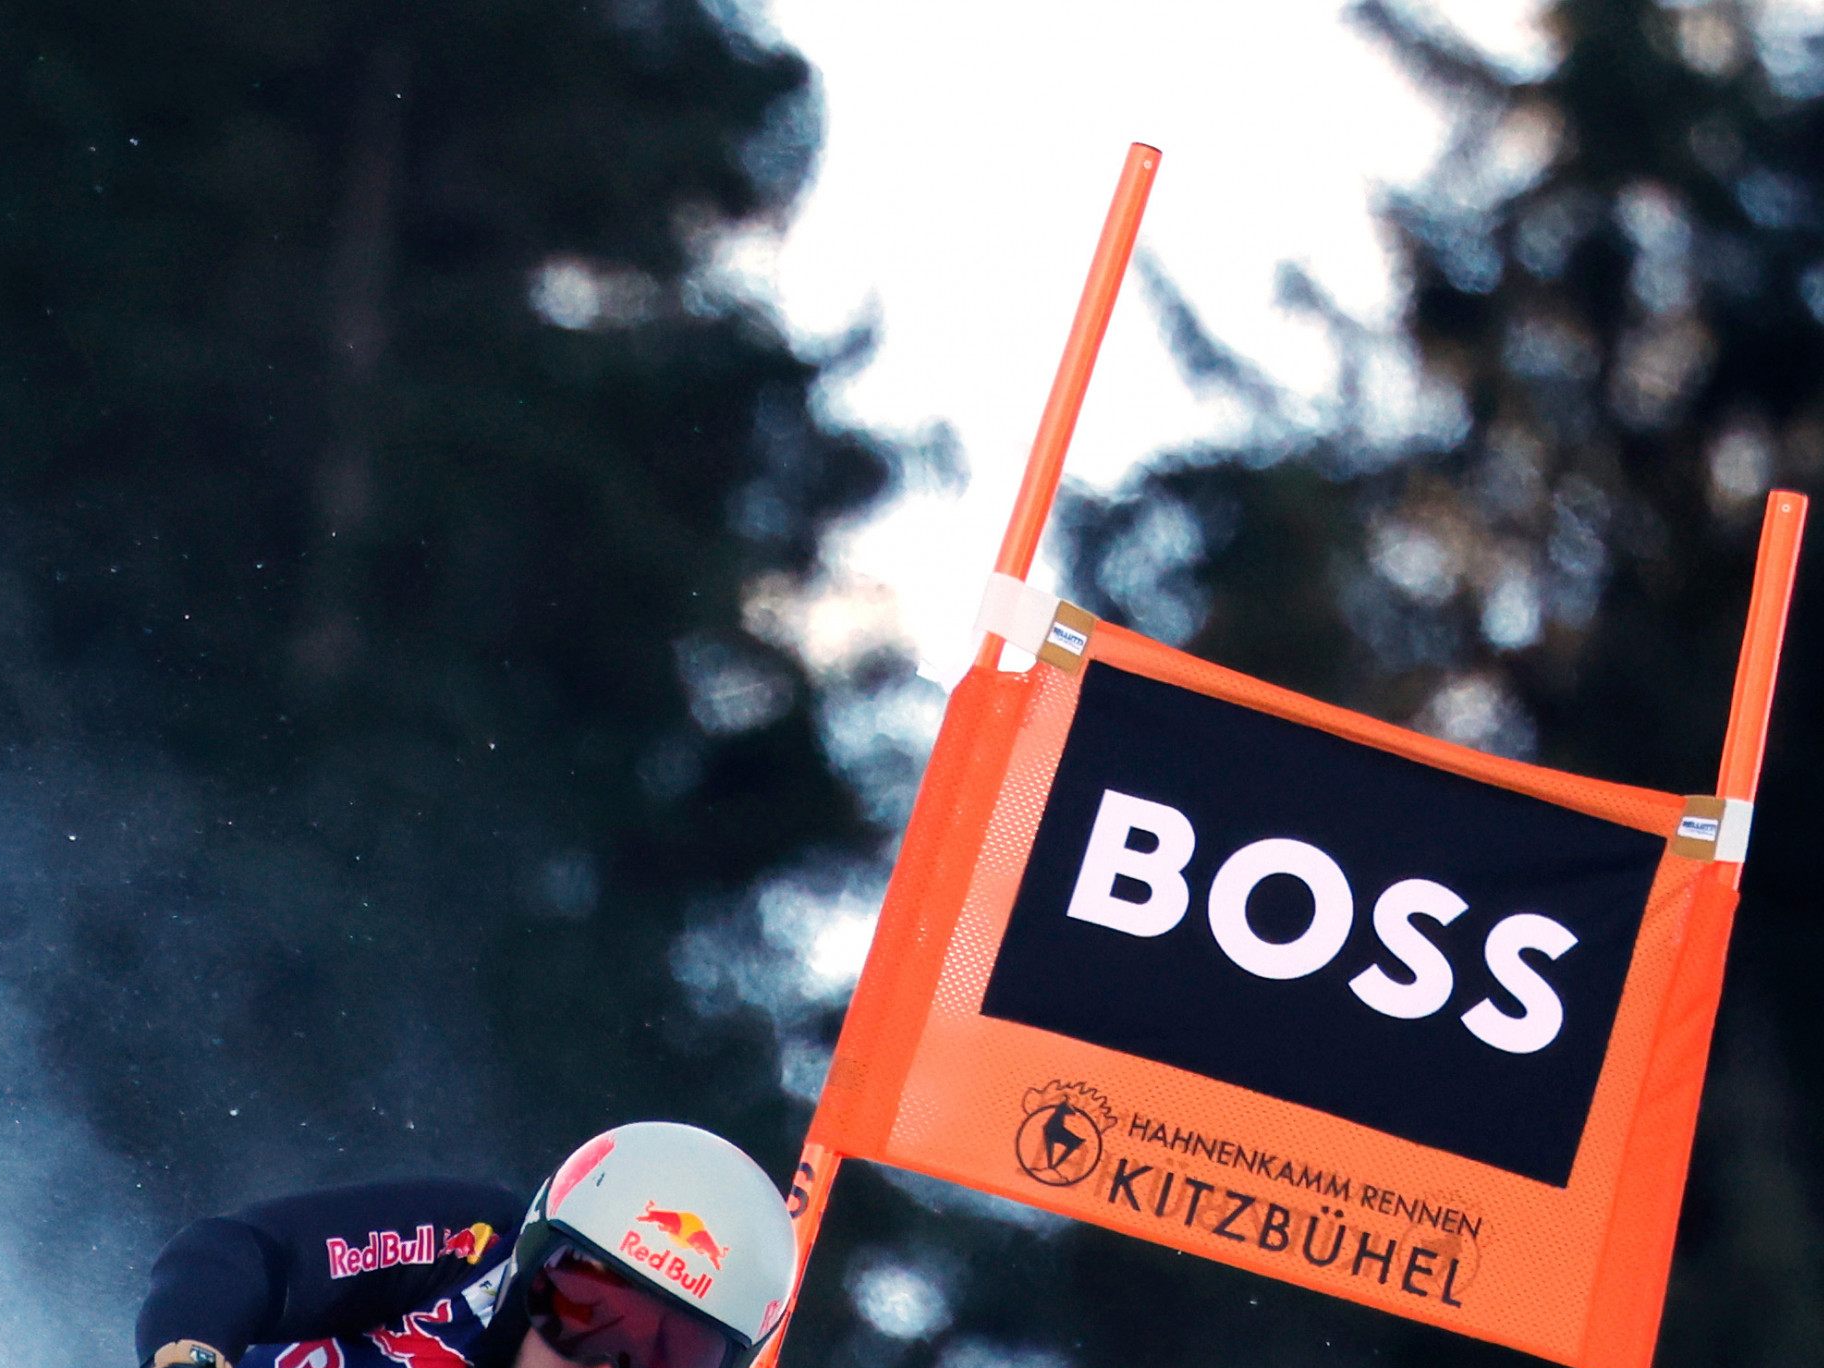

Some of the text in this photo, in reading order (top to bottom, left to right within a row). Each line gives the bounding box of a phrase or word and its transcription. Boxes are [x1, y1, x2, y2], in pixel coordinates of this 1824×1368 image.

[1066, 789, 1578, 1054] BOSS
[1108, 1159, 1462, 1308] KITZBÜHEL
[1128, 1112, 1483, 1238] HAHNENKAMM RENNEN
[326, 1223, 435, 1279] Red Bull
[619, 1229, 713, 1299] Red Bull
